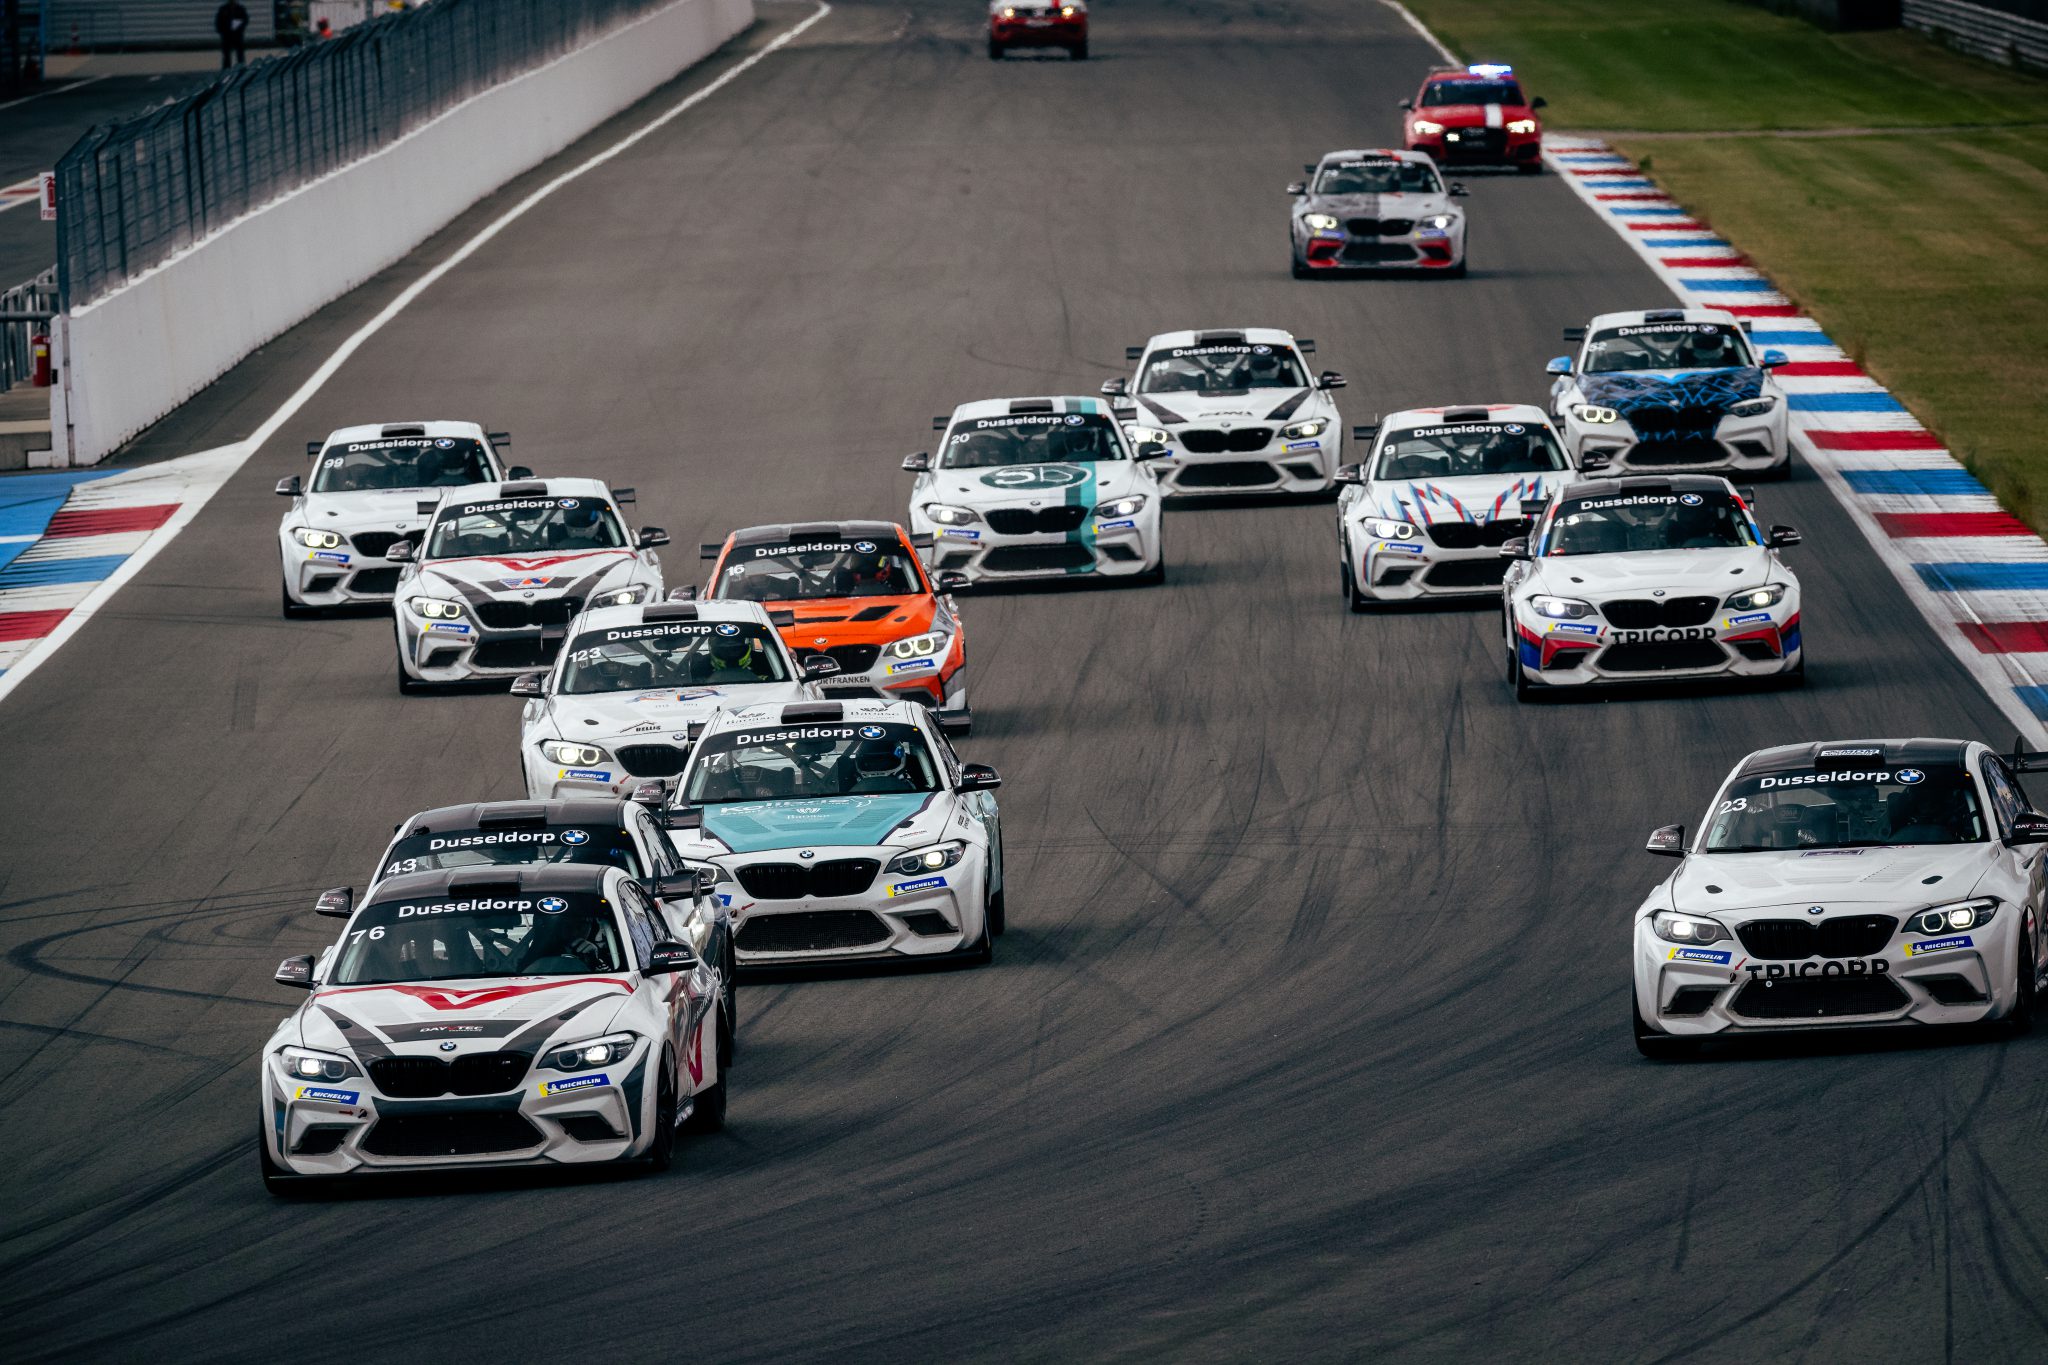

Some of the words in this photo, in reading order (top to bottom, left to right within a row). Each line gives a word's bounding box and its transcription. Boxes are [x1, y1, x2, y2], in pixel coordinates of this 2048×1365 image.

[1618, 325, 1698, 336] Dusseldorp
[1172, 345, 1251, 357] Dusseldorp
[977, 415, 1062, 429] Dusseldorp
[1413, 424, 1502, 438] Dusseldorp
[348, 439, 433, 453] Dusseldorp
[951, 433, 970, 445] 20
[1383, 444, 1396, 455] 9
[324, 457, 344, 469] 99
[464, 500, 555, 515] Dusseldorp
[1580, 494, 1678, 510] Dusseldorp
[755, 542, 852, 558] Dusseldorp
[727, 564, 745, 577] 16
[607, 625, 712, 641] Dusseldorp
[569, 646, 601, 663] 123
[737, 728, 854, 746] Dusseldorp
[700, 753, 725, 768] 17
[1760, 770, 1891, 790] Dusseldorp
[1720, 797, 1747, 815] 23
[430, 831, 555, 850] Dusseldorp
[386, 858, 417, 875] 43
[904, 879, 940, 891] MICHELIN
[398, 898, 532, 918] Dusseldorp
[350, 926, 386, 945] 76
[1923, 939, 1965, 951] MICHELIN
[1685, 952, 1724, 961] MICHELIN
[559, 1077, 602, 1089] MICHELIN
[311, 1091, 352, 1101] MICHELIN
